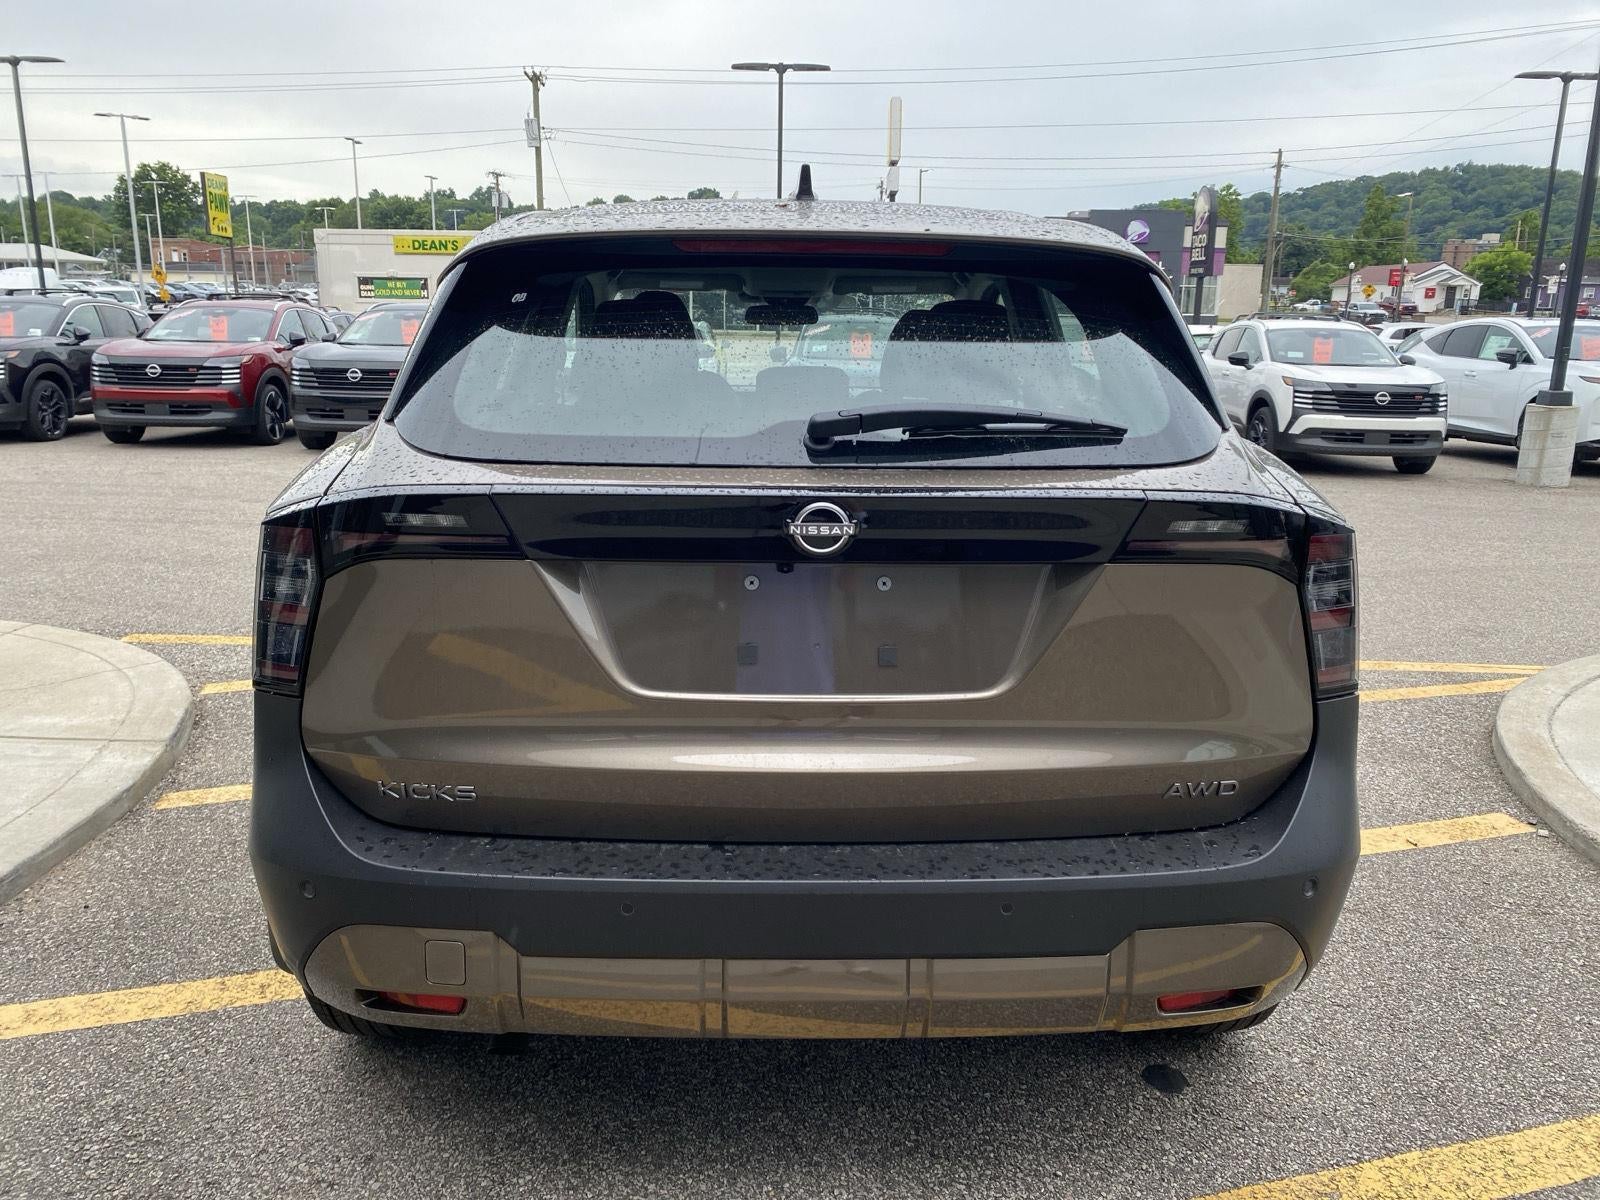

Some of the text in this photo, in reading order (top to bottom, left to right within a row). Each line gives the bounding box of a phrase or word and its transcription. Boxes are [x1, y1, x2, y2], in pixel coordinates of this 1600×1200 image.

[208, 191, 228, 214] PAWN
[412, 239, 459, 251] DEAN'S
[1192, 234, 1206, 248] TACO
[1191, 247, 1206, 261] BELL
[790, 525, 853, 535] NISSAN
[377, 780, 477, 802] KICKS
[1161, 780, 1239, 800] AWD
